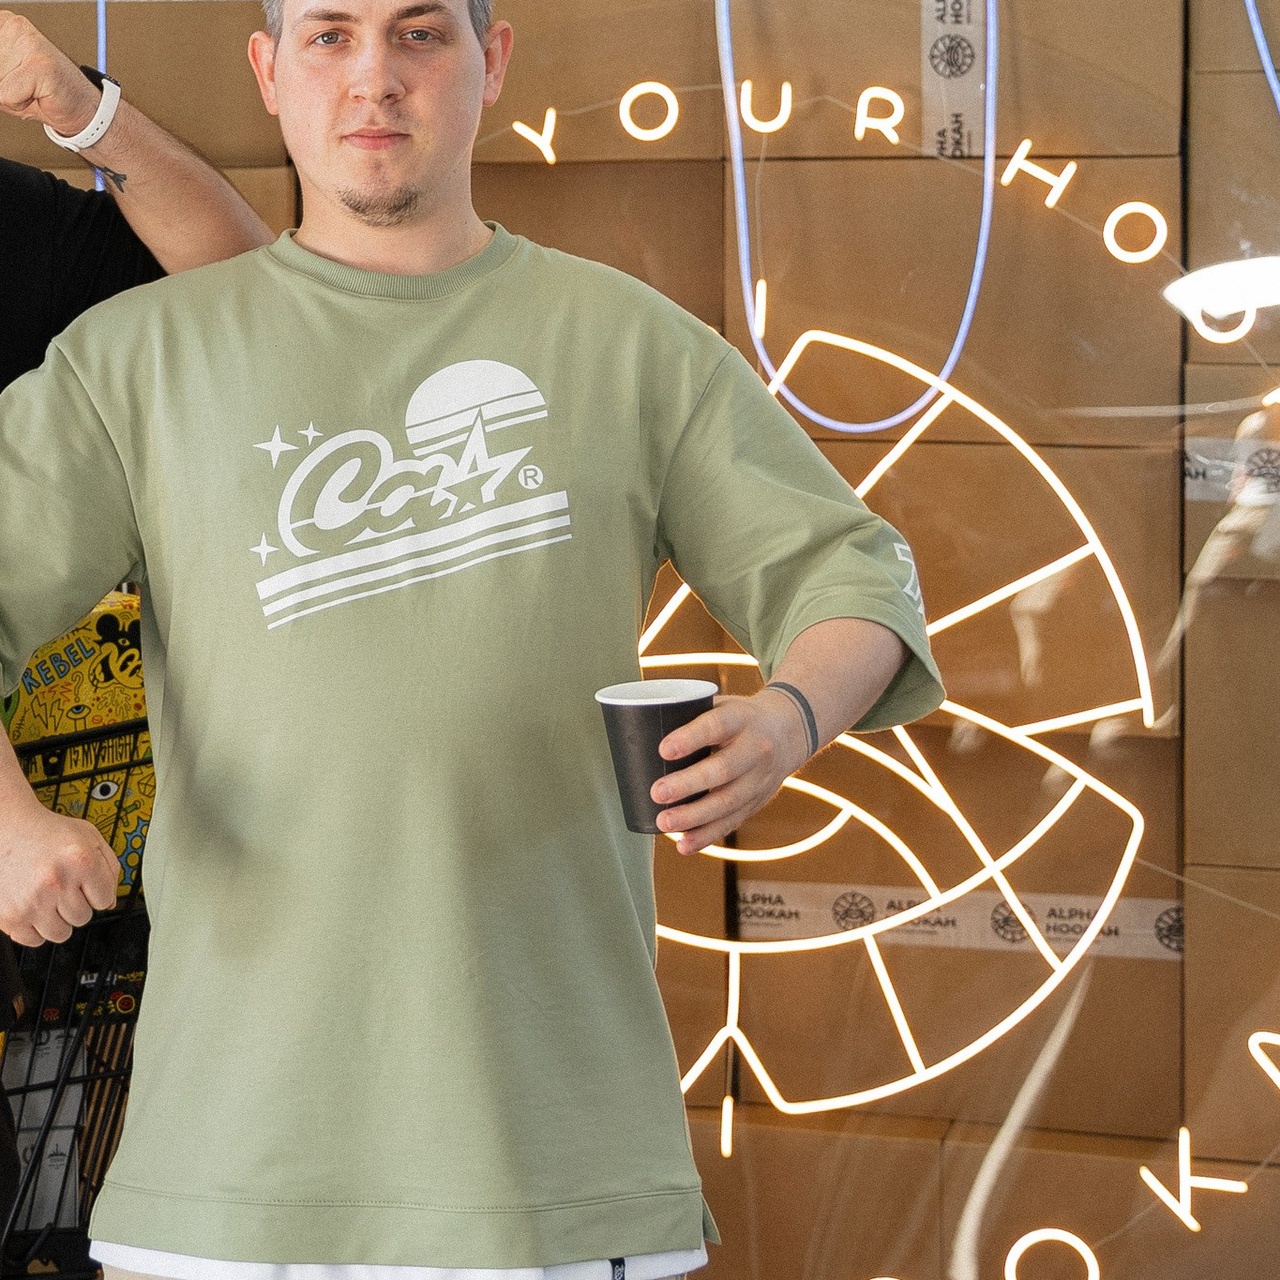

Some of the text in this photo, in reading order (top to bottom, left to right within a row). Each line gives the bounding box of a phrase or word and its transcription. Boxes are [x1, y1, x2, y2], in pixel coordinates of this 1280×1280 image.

[513, 78, 905, 165] YOUR
[22, 637, 97, 696] REBEL
[1046, 907, 1097, 920] ALPH
